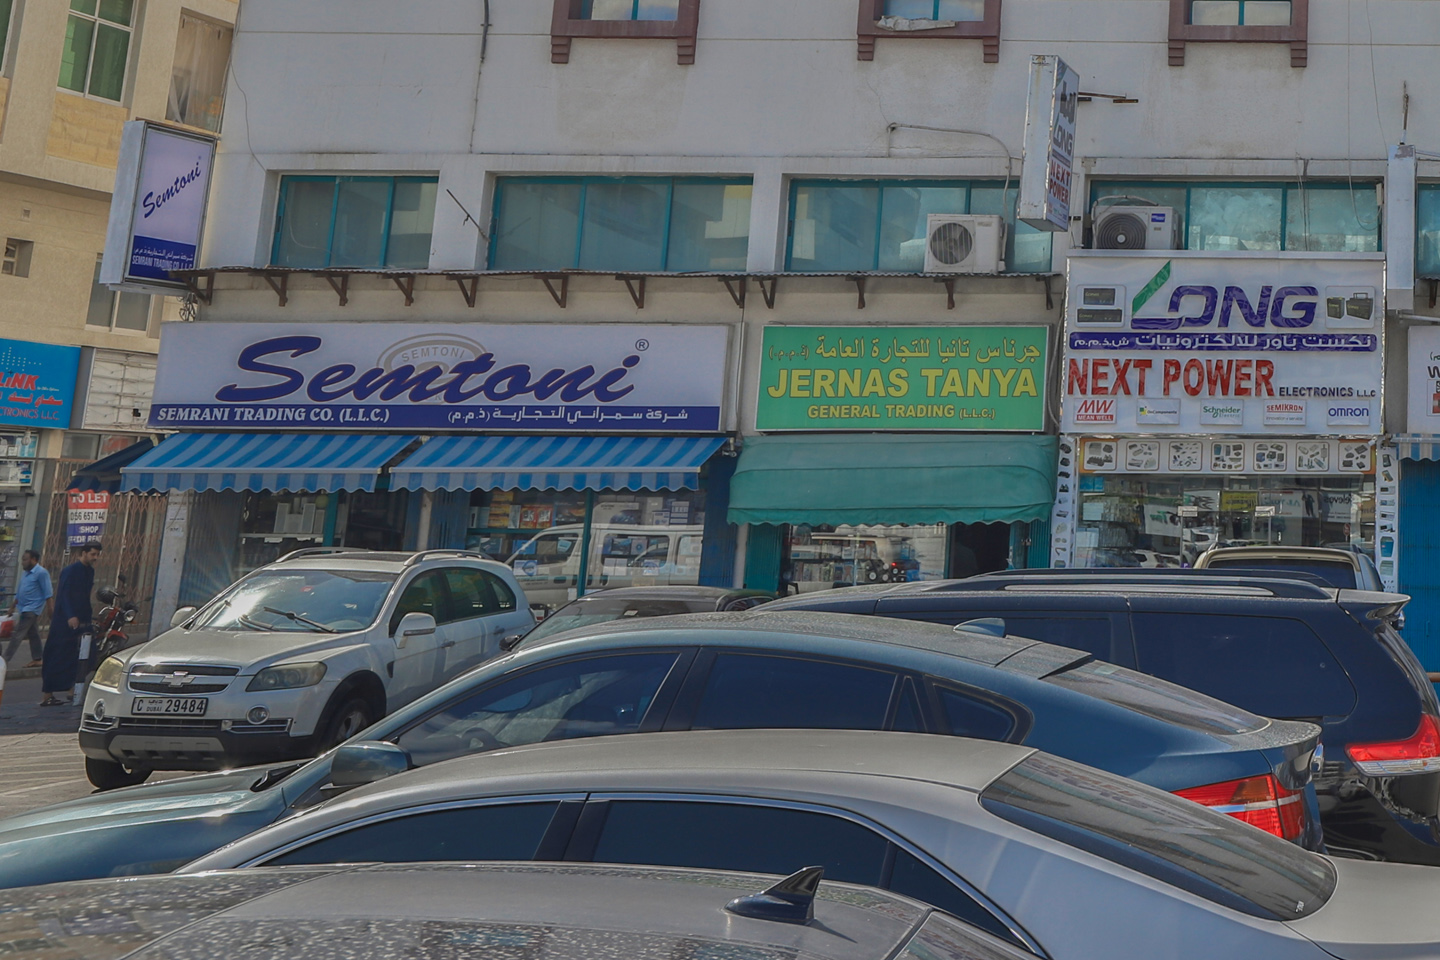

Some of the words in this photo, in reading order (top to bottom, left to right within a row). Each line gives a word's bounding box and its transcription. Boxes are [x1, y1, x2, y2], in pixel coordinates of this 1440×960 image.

[1050, 160, 1071, 187] NEXT
[143, 161, 202, 219] Semtoni
[1048, 178, 1069, 205] POWER
[1130, 259, 1320, 331] LONG
[814, 334, 865, 358] العامة
[870, 336, 931, 364] للتجارة
[937, 335, 970, 364] تانيا
[1264, 334, 1298, 349] باور
[1301, 333, 1372, 350] نكست
[401, 346, 465, 362] SEMTONI
[975, 337, 1041, 364] جرناس
[214, 335, 641, 403] Semtoni
[767, 367, 910, 399] JERNAS
[920, 367, 1039, 398] TANYA
[1067, 358, 1153, 396] NEXT
[1162, 359, 1275, 398] POWER
[1279, 386, 1354, 397] ELECTRONICS
[157, 406, 231, 422] SEMRANI
[233, 406, 307, 422] TRADING
[309, 406, 335, 422] CO.
[492, 406, 565, 422] التجارية
[566, 406, 643, 425] سمراني
[645, 408, 689, 423] شركة
[807, 404, 881, 419] GENERAL
[885, 404, 956, 419] TRADING
[1202, 405, 1242, 418] Schneider
[1266, 403, 1304, 411] SEMIKRON
[1327, 407, 1370, 417] OMRON
[71, 492, 85, 503] TO
[88, 492, 108, 503] LET
[79, 526, 99, 534] SHOP
[137, 699, 144, 712] C
[165, 699, 204, 712] 29484
